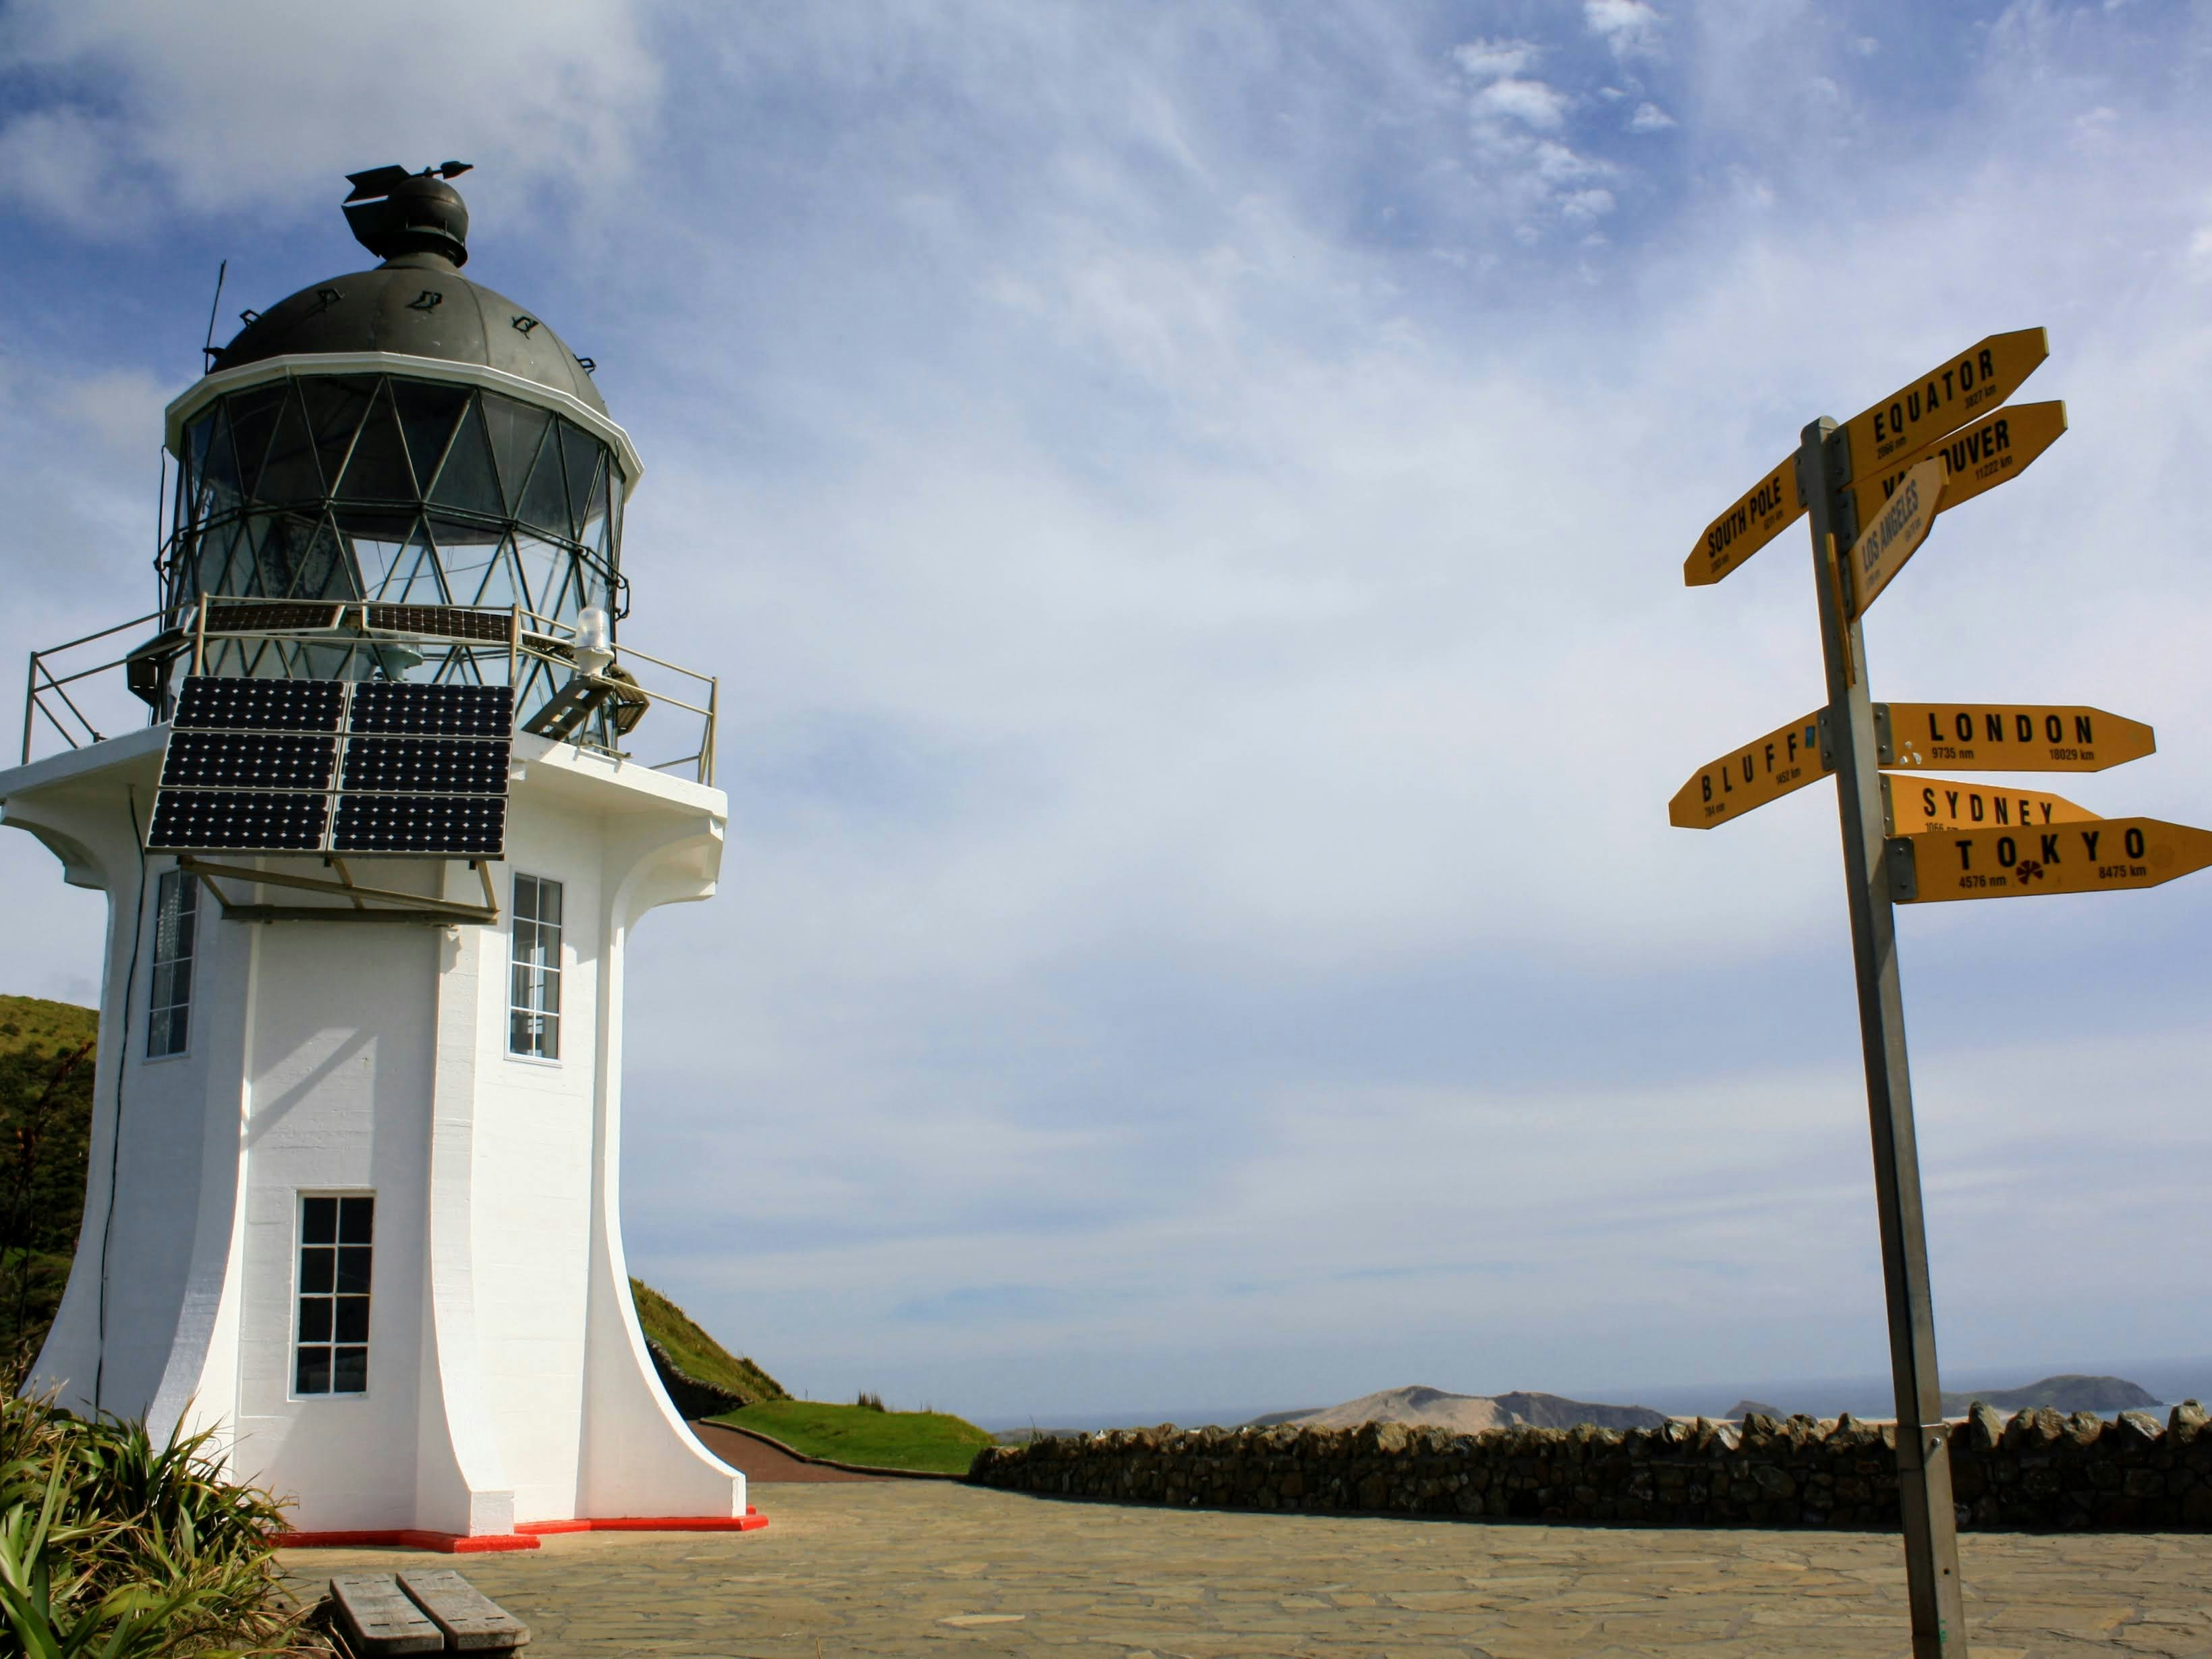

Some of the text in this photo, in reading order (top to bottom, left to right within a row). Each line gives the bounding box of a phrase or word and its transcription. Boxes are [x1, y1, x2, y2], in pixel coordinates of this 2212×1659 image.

[1873, 348, 1993, 443] EQUATOR
[1982, 384, 1997, 400] km
[1882, 418, 2011, 501] VOUVER
[1975, 455, 2013, 481] 11222 km
[1708, 505, 1747, 559] SOUTH
[1750, 476, 1782, 524] POLE
[1862, 530, 1879, 572] LOS
[1880, 478, 1919, 549] ANGELES
[1929, 713, 2093, 743] LONDON
[1701, 733, 1797, 803] BLUFF
[1931, 747, 1975, 760] 9735 nm
[2049, 748, 2094, 761] 18029 km
[1790, 768, 1801, 778] km
[1923, 787, 2053, 826] SYDNEY
[1956, 828, 2146, 871] TOKYO
[1959, 875, 2006, 889] 4576 nm
[2099, 865, 2147, 880] 8475 km
